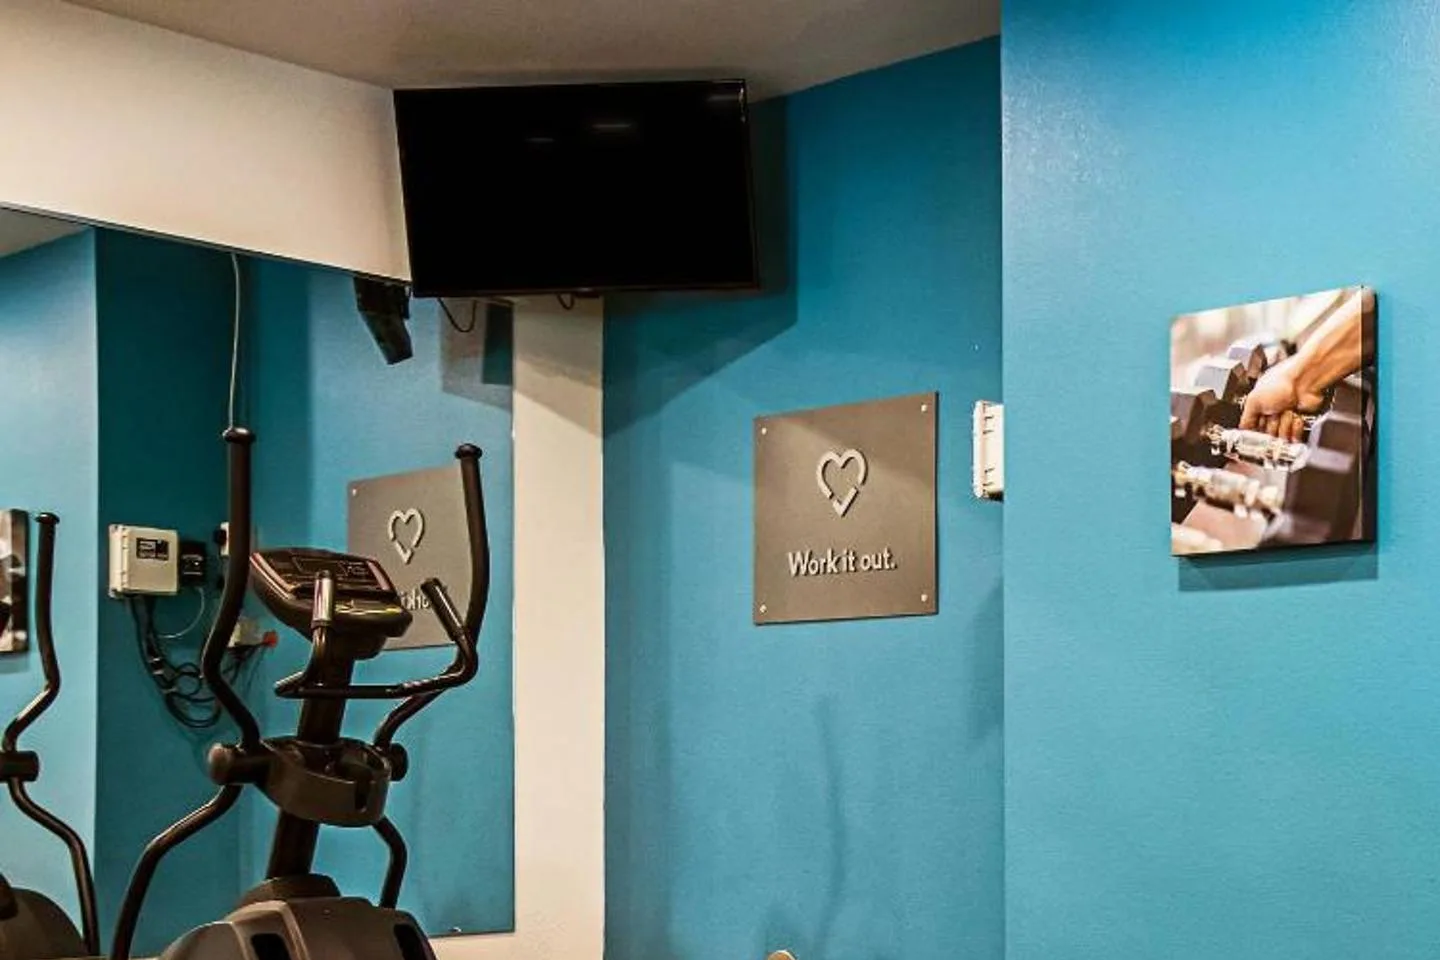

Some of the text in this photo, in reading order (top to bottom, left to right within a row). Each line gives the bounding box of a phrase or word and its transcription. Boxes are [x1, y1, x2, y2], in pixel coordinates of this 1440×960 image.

[788, 547, 896, 576] Work it out.
